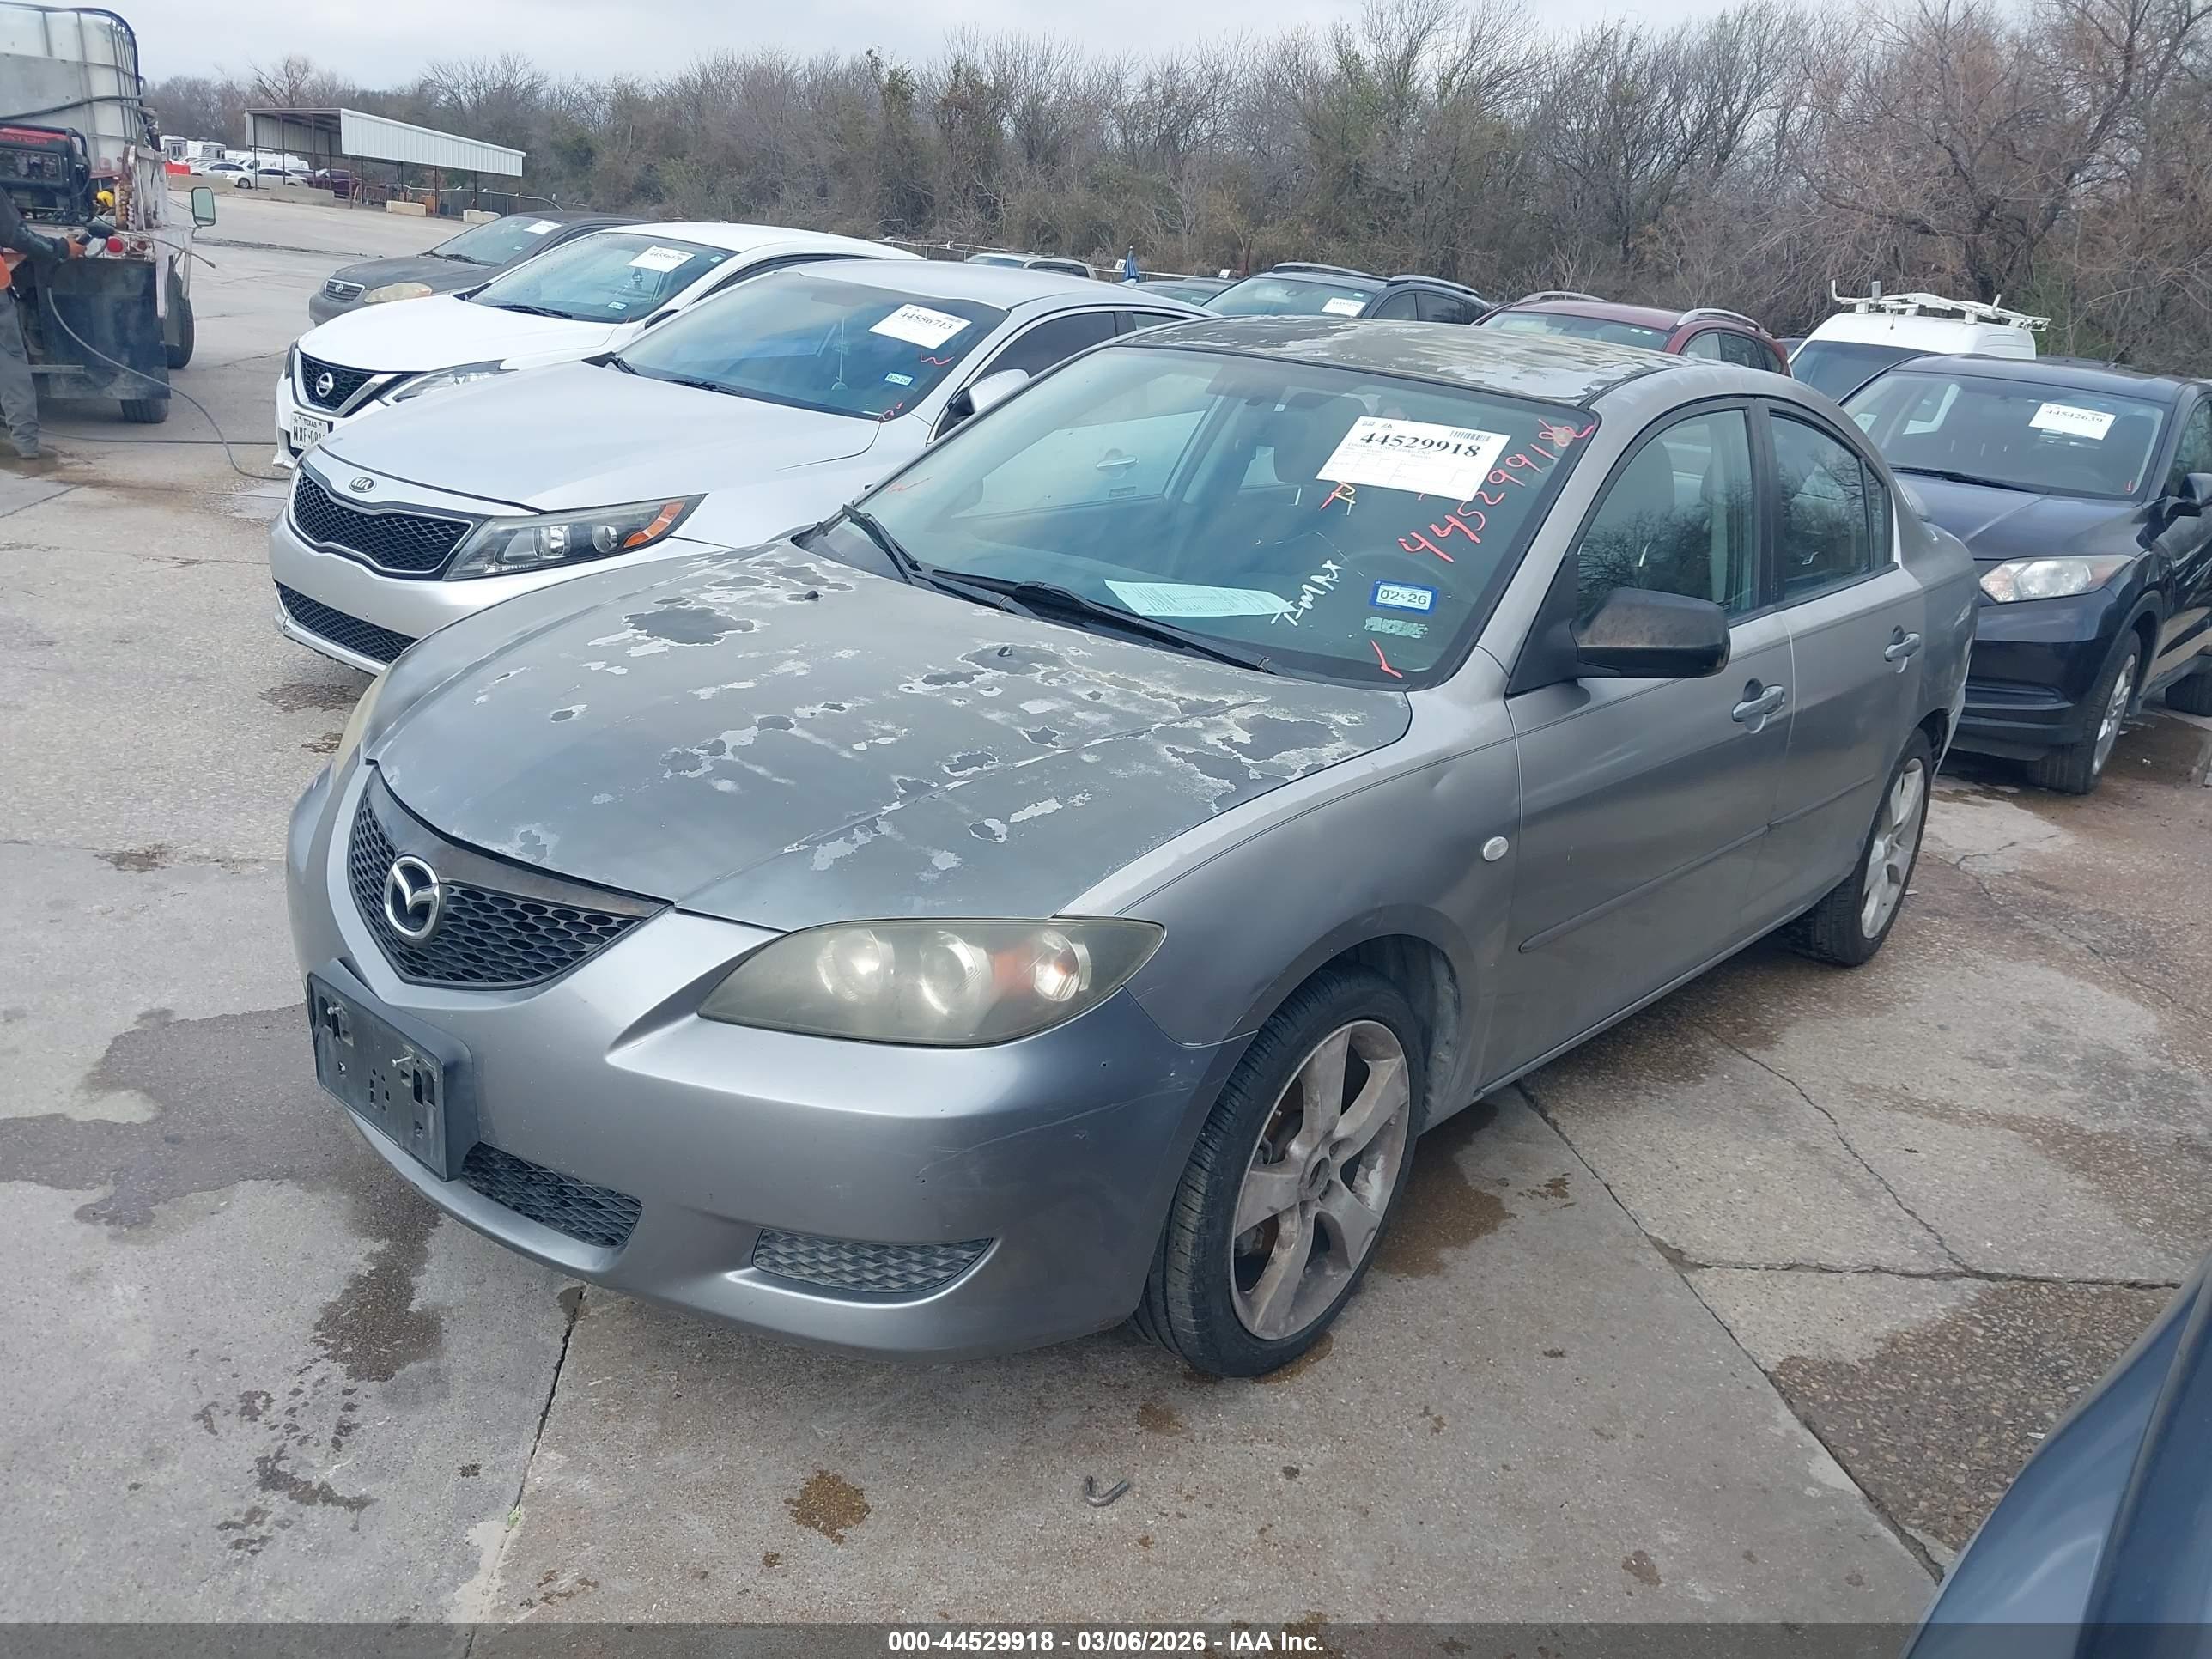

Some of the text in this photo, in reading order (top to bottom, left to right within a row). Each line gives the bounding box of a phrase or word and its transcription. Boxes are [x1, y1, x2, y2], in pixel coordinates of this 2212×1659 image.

[303, 417, 318, 428] TEXAS
[1360, 431, 1481, 458] 44529918
[350, 477, 372, 488] KIA
